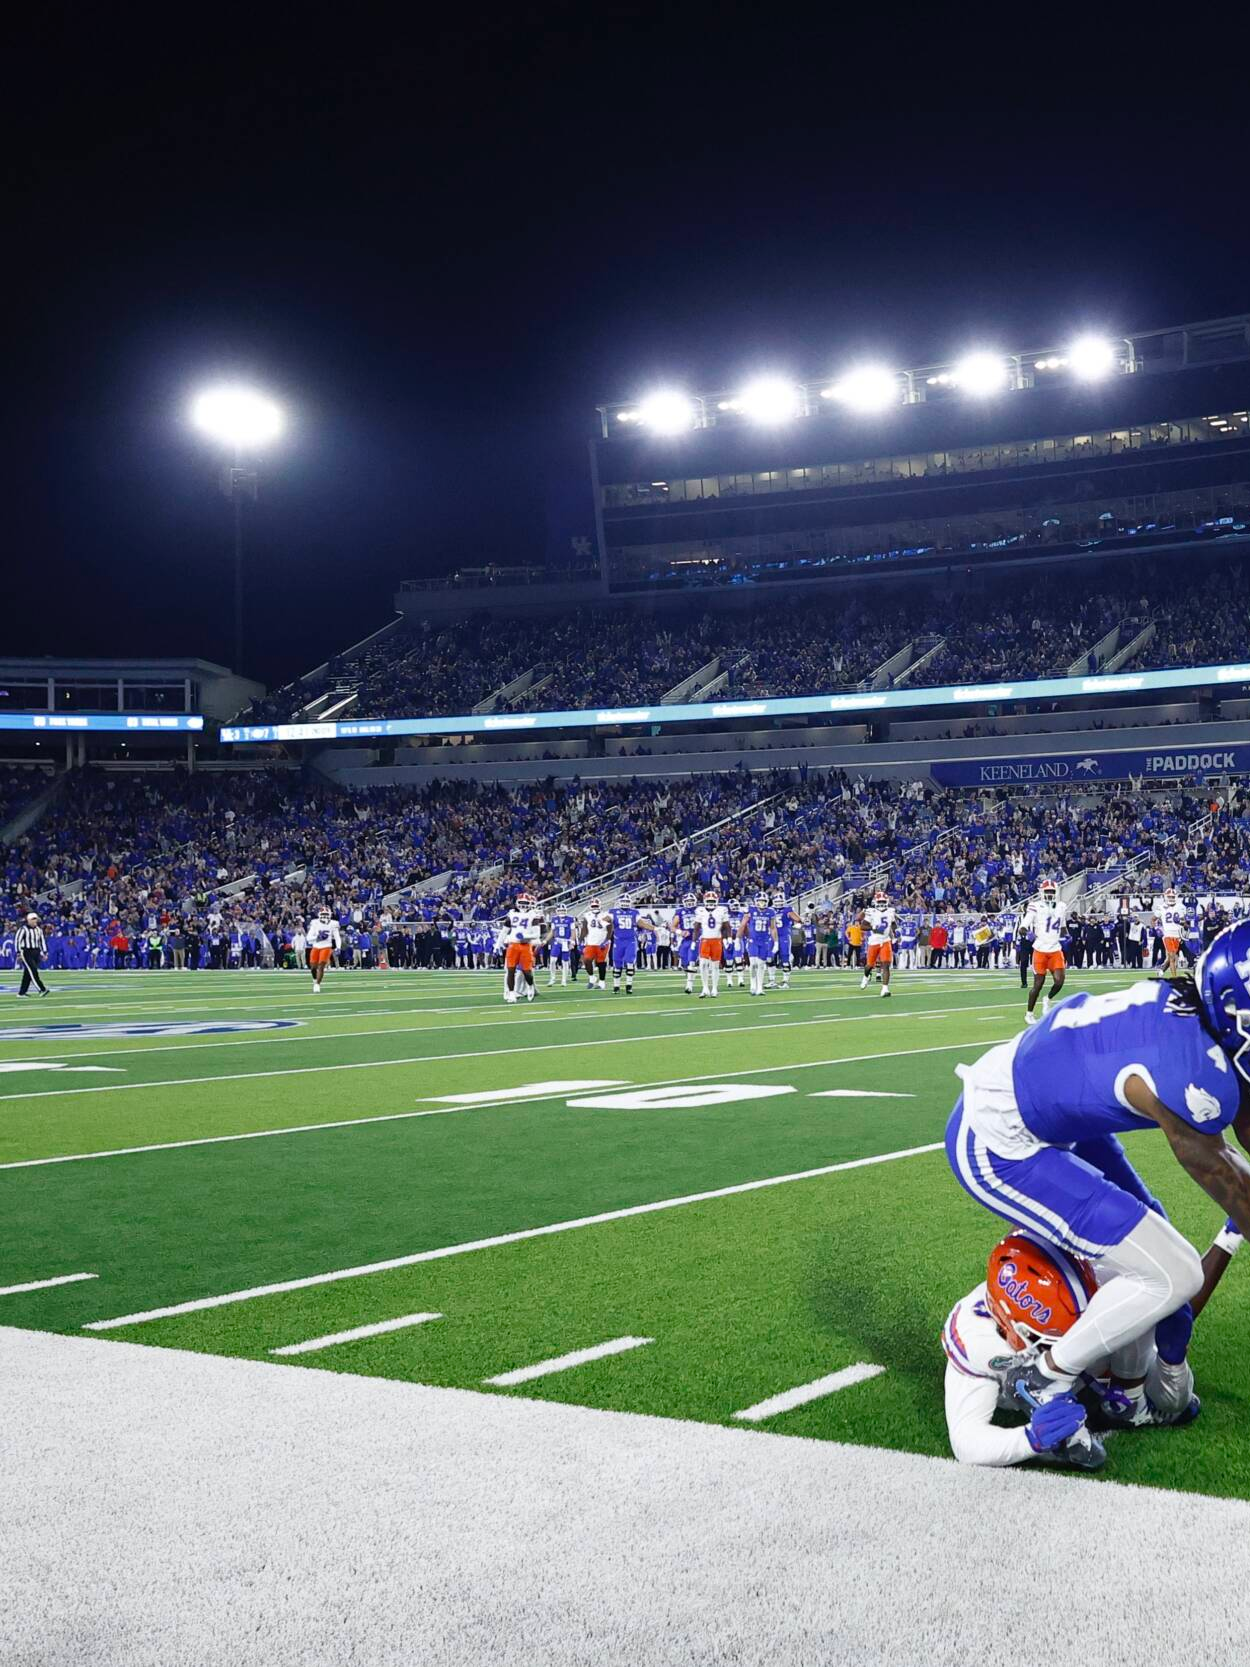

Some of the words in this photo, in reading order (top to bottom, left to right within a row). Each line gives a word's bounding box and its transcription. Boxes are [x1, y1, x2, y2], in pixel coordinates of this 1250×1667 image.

[1153, 752, 1235, 772] PADDOCK
[980, 762, 1069, 781] KEENELAND
[511, 916, 529, 930] 24
[618, 917, 632, 930] 50
[707, 916, 716, 929] 8
[754, 919, 767, 932] 81
[1045, 916, 1061, 933] 14
[998, 1263, 1052, 1325] Gators
